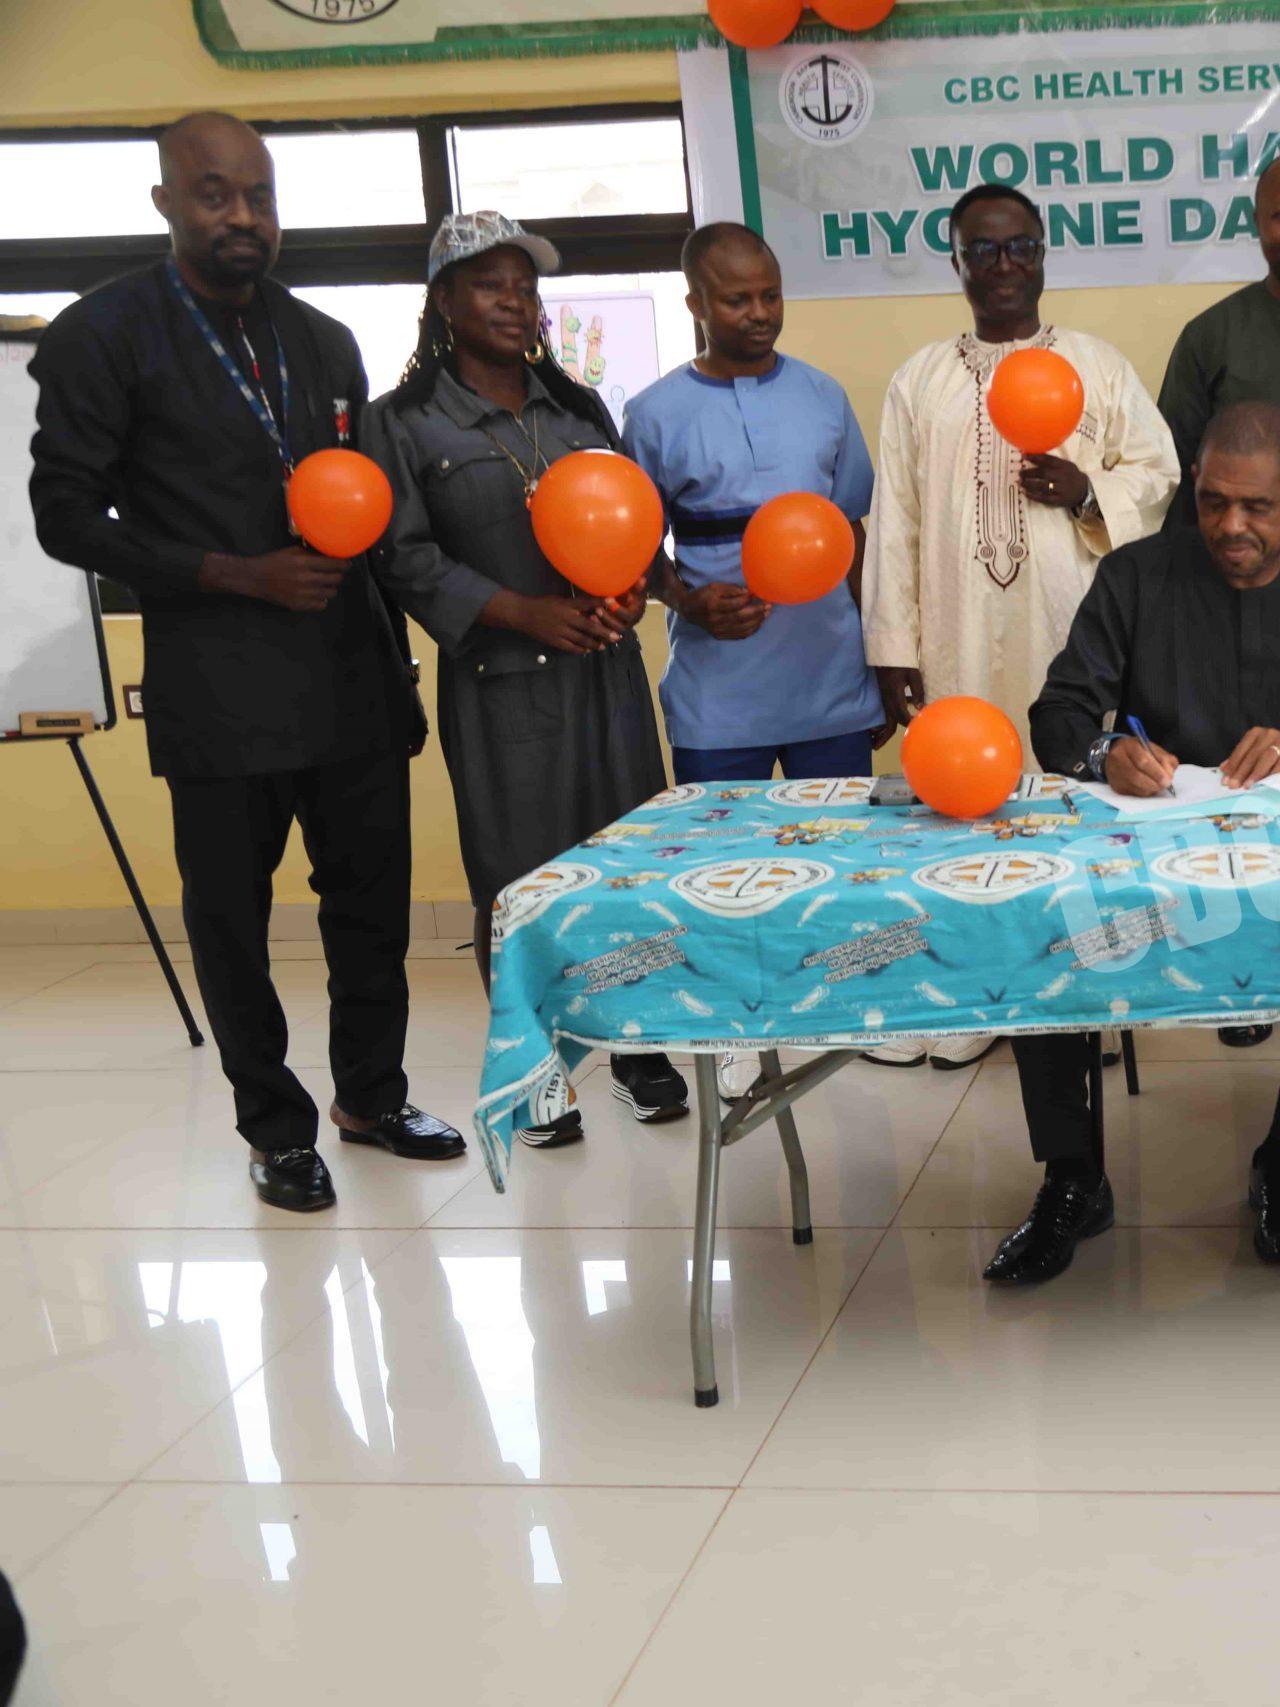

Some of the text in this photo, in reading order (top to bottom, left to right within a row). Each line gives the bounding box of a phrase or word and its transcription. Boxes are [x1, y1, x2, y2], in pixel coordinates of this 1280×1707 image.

[944, 75, 1021, 105] CBC
[1033, 67, 1183, 101] HEALTH
[818, 128, 841, 138] 1975
[912, 137, 1174, 191] WORLD
[822, 200, 1143, 257] HYGNE
[1168, 197, 1259, 242] DA
